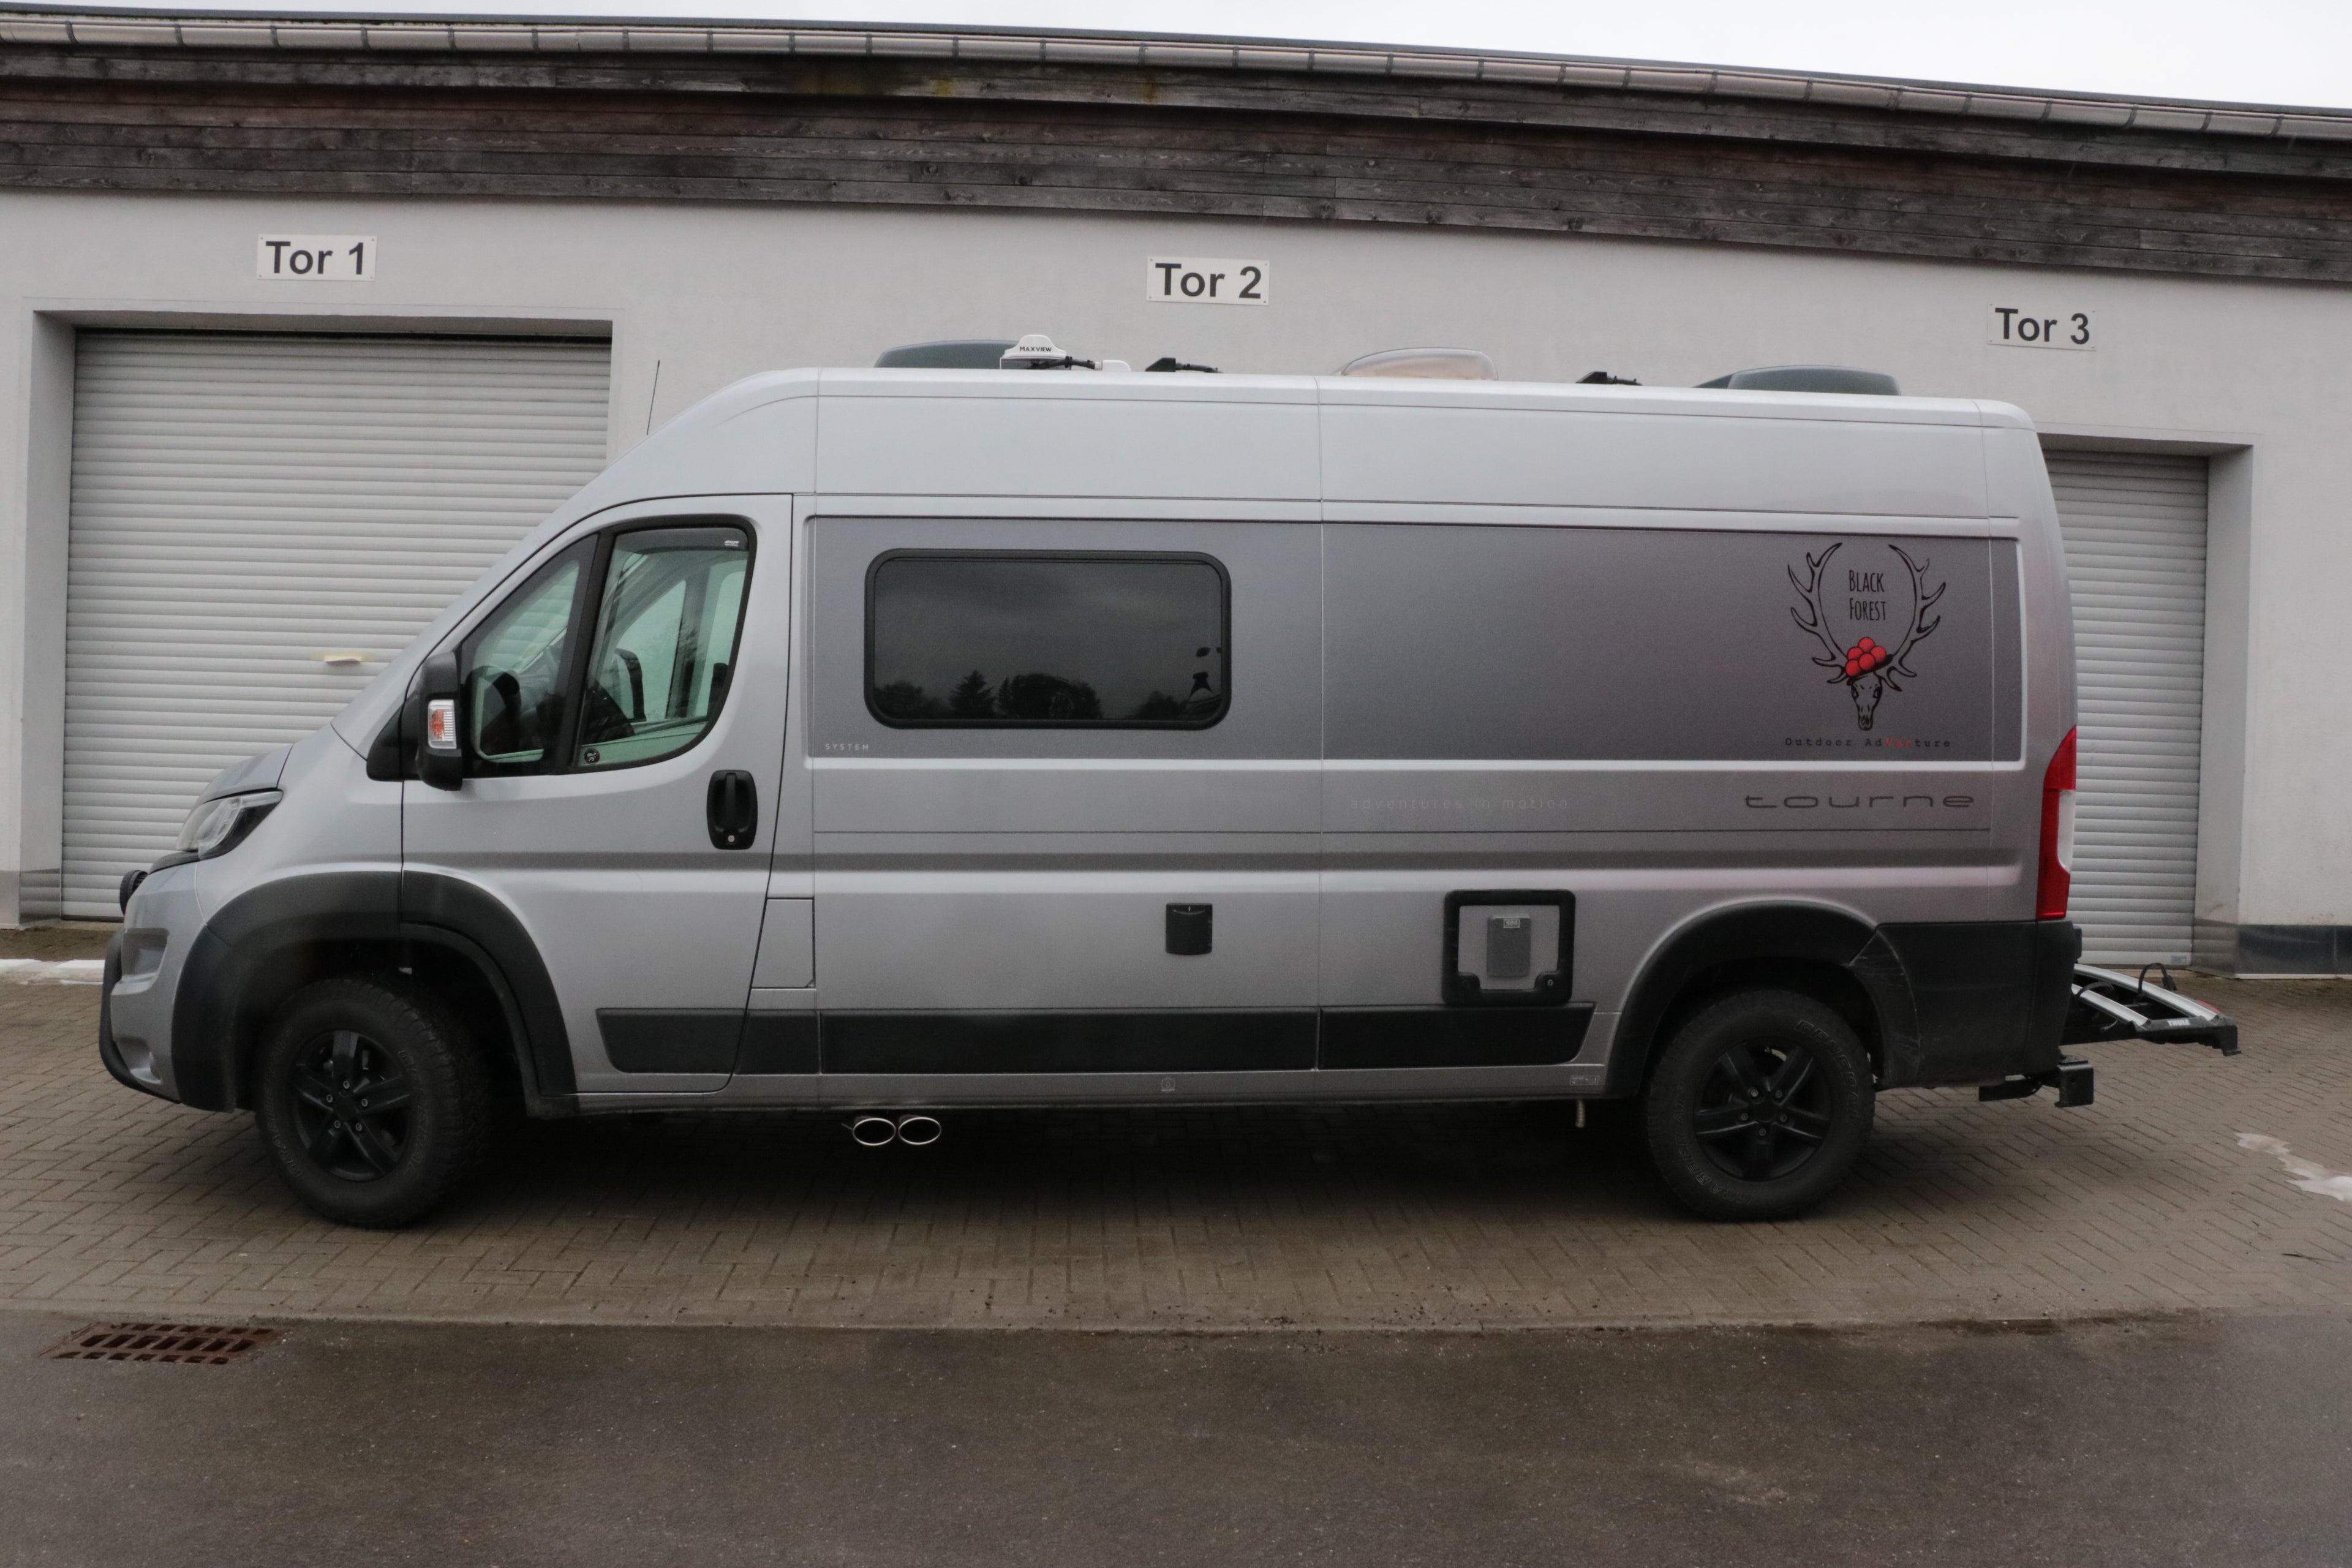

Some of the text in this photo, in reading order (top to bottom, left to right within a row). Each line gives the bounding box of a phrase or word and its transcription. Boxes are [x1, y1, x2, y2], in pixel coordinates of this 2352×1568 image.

[266, 241, 364, 275] Tor 1
[1155, 263, 1262, 299] Tor 2
[1995, 307, 2090, 345] Tor 3
[1849, 570, 1885, 592] BLACK
[1850, 598, 1887, 620] FOREST
[1785, 737, 1951, 747] Outdoor AdVanture
[1350, 797, 1568, 809] adventures in motion
